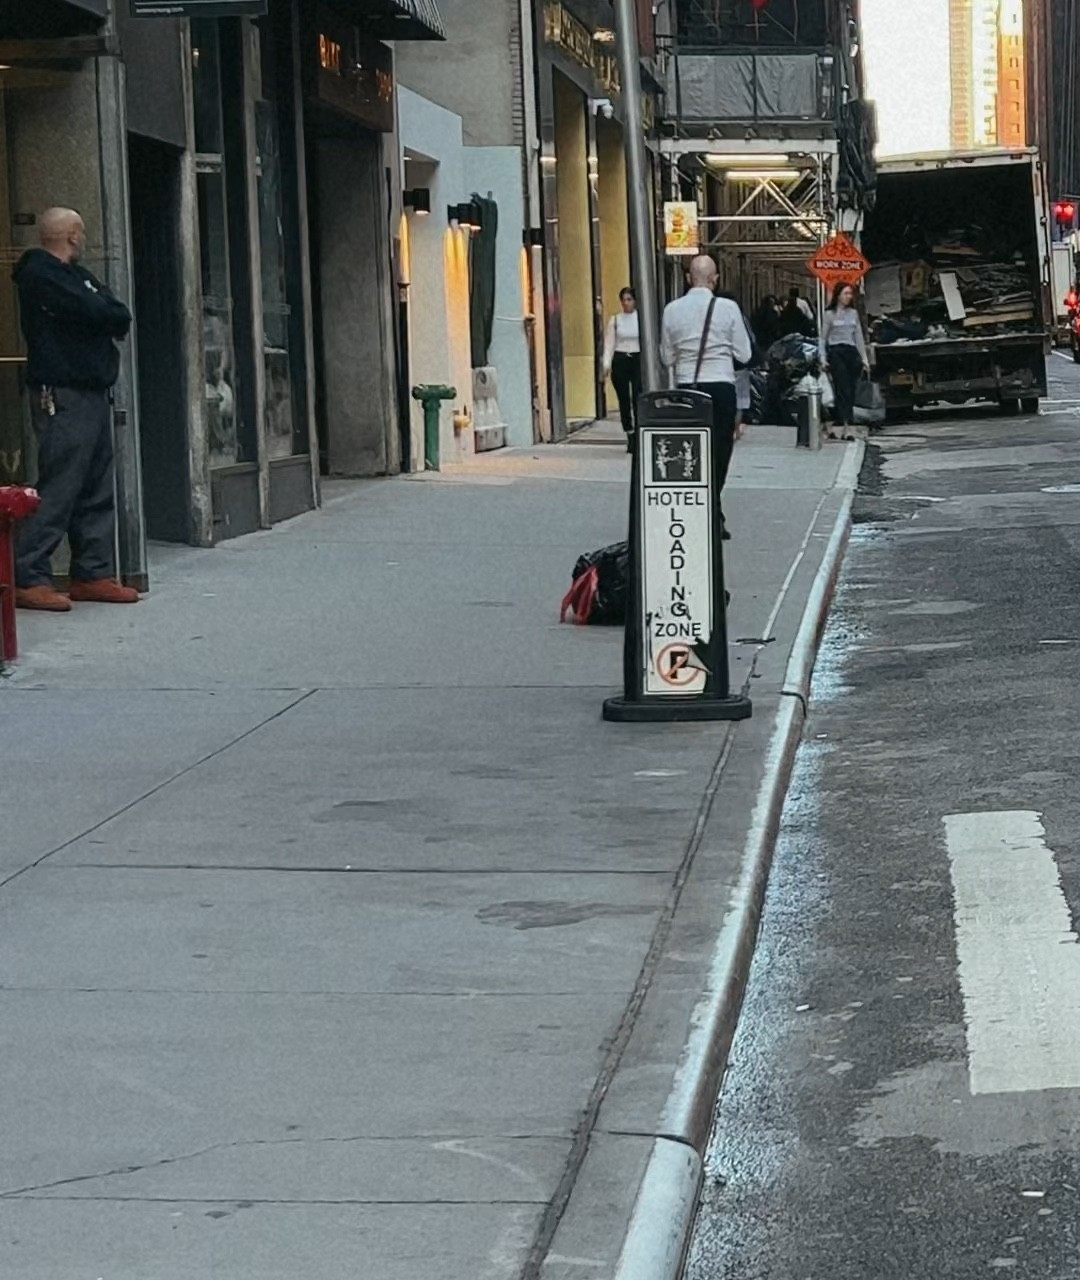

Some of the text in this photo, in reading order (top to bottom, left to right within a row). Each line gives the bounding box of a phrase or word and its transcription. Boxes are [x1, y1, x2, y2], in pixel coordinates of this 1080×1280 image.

[647, 491, 705, 506] HOTEL
[669, 507, 686, 617] LOADING
[655, 622, 702, 637] ZONE
